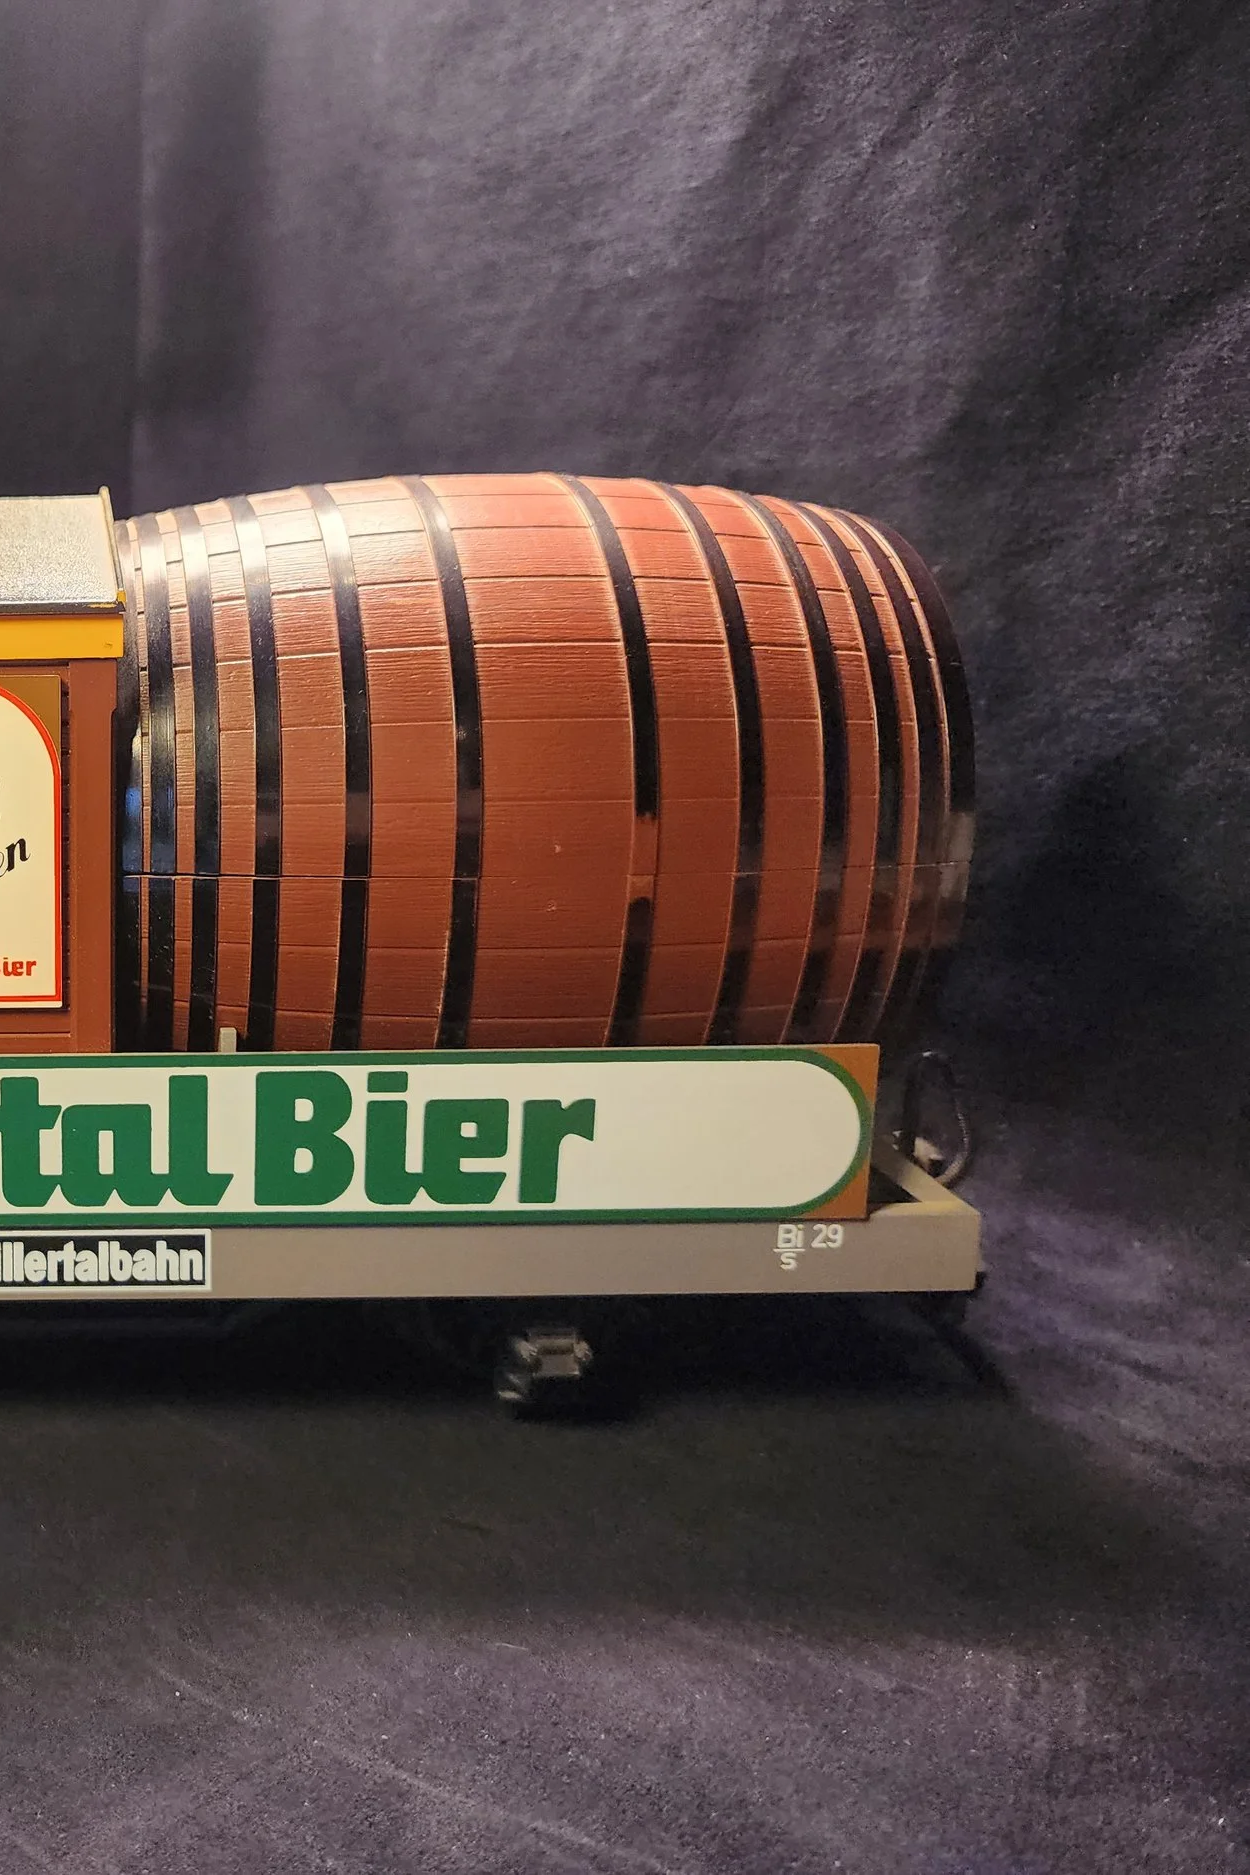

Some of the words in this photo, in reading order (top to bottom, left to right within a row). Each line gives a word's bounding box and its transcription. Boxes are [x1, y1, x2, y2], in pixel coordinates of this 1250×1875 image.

[254, 1071, 596, 1205] Bier
[776, 1223, 805, 1248] Bi
[811, 1223, 844, 1248] 29
